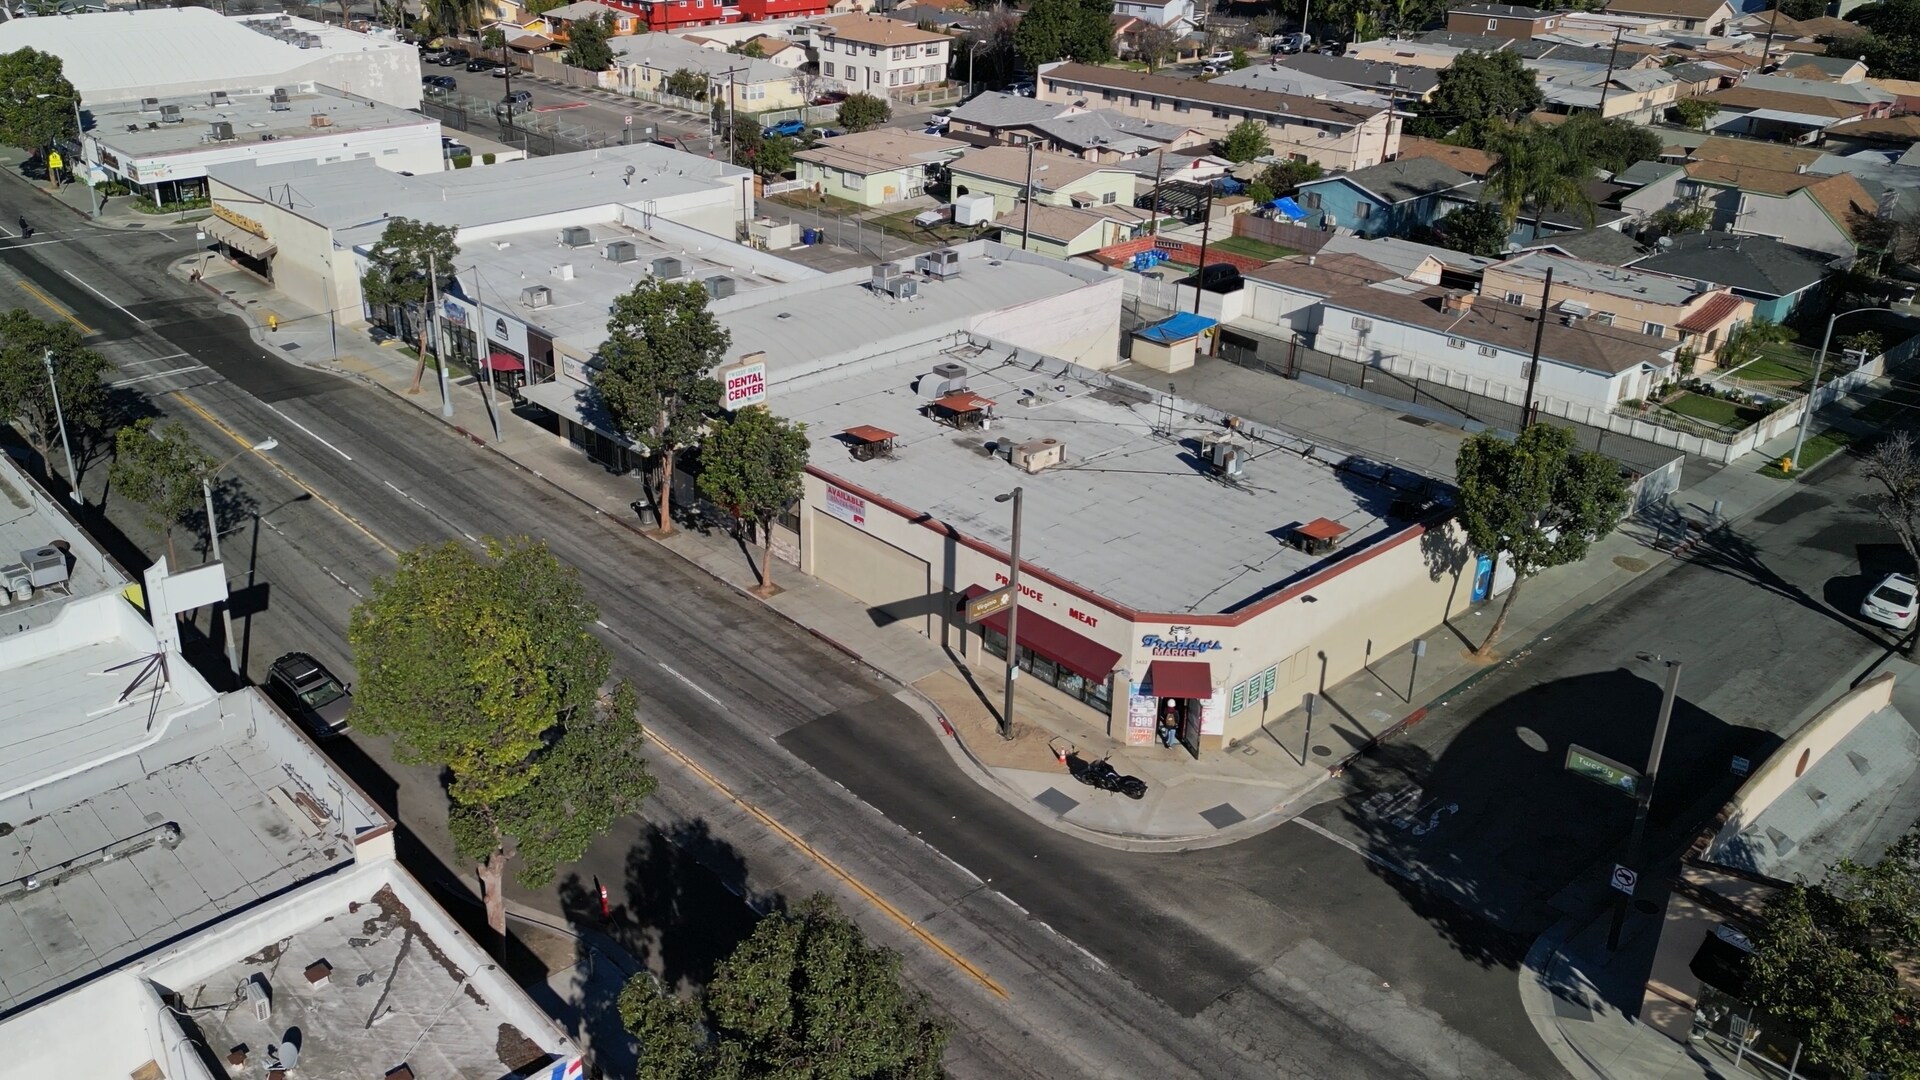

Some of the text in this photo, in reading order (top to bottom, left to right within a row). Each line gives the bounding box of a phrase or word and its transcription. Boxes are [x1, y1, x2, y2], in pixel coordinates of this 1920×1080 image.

[728, 372, 763, 390] DENTAL
[728, 383, 764, 401] CENTER
[828, 485, 864, 508] AVAILABLE
[995, 572, 1098, 628] PRDUCE MEAT
[1142, 634, 1222, 653] Freddy's
[1578, 756, 1615, 778] Tweedy
